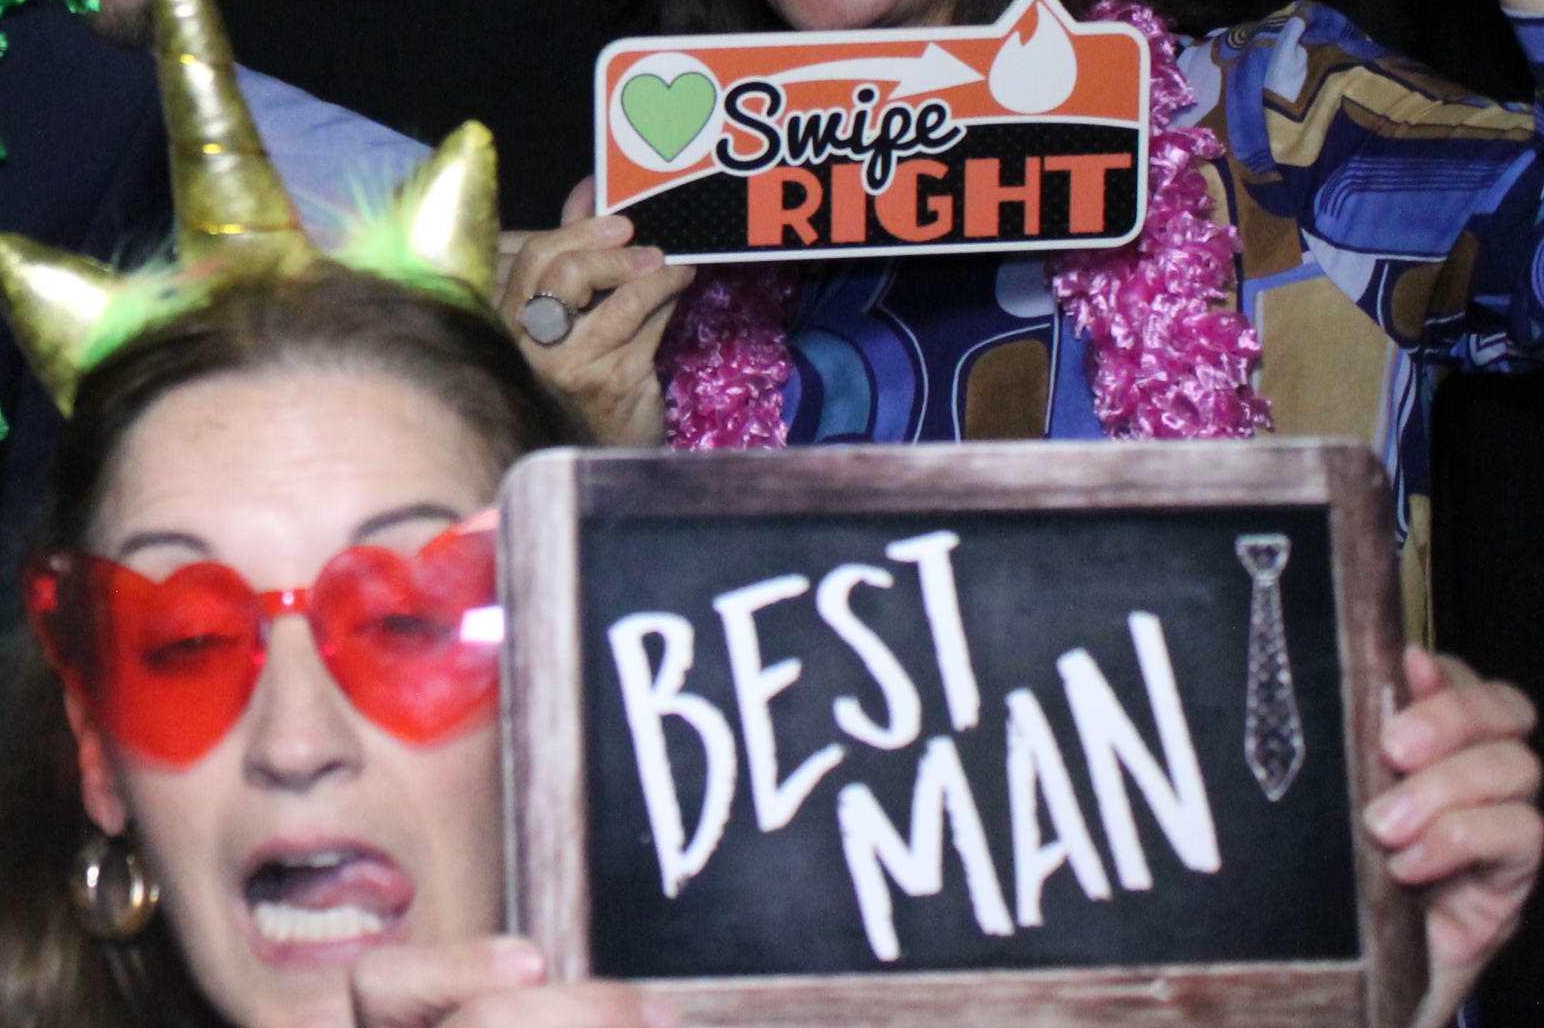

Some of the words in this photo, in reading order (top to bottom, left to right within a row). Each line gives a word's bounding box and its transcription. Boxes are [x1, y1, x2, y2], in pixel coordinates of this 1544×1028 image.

[714, 81, 963, 191] Swipe
[748, 152, 1132, 247] RIGHT
[608, 530, 981, 899] BEST
[837, 610, 1222, 962] MAN
